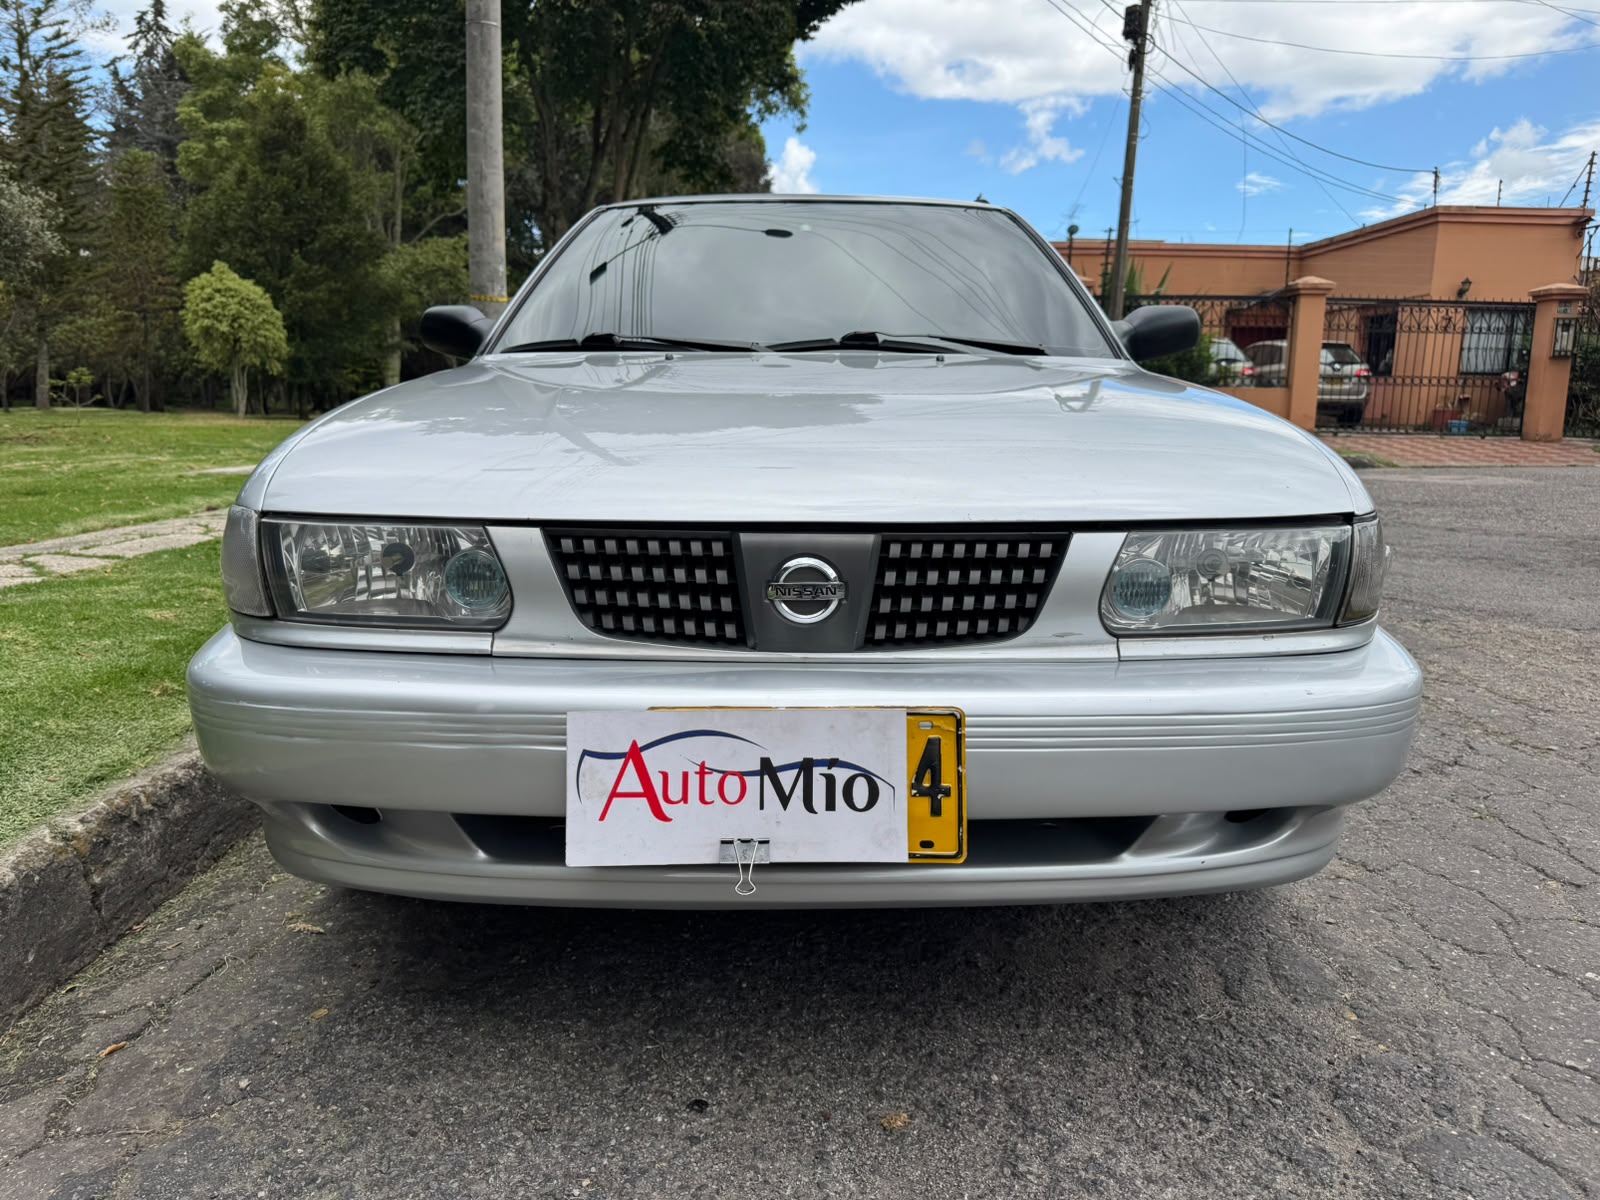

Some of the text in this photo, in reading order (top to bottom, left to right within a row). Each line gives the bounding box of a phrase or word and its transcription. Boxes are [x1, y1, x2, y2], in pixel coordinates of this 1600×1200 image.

[775, 586, 837, 597] NISSAN
[599, 739, 747, 822] Auto
[911, 735, 952, 818] 4
